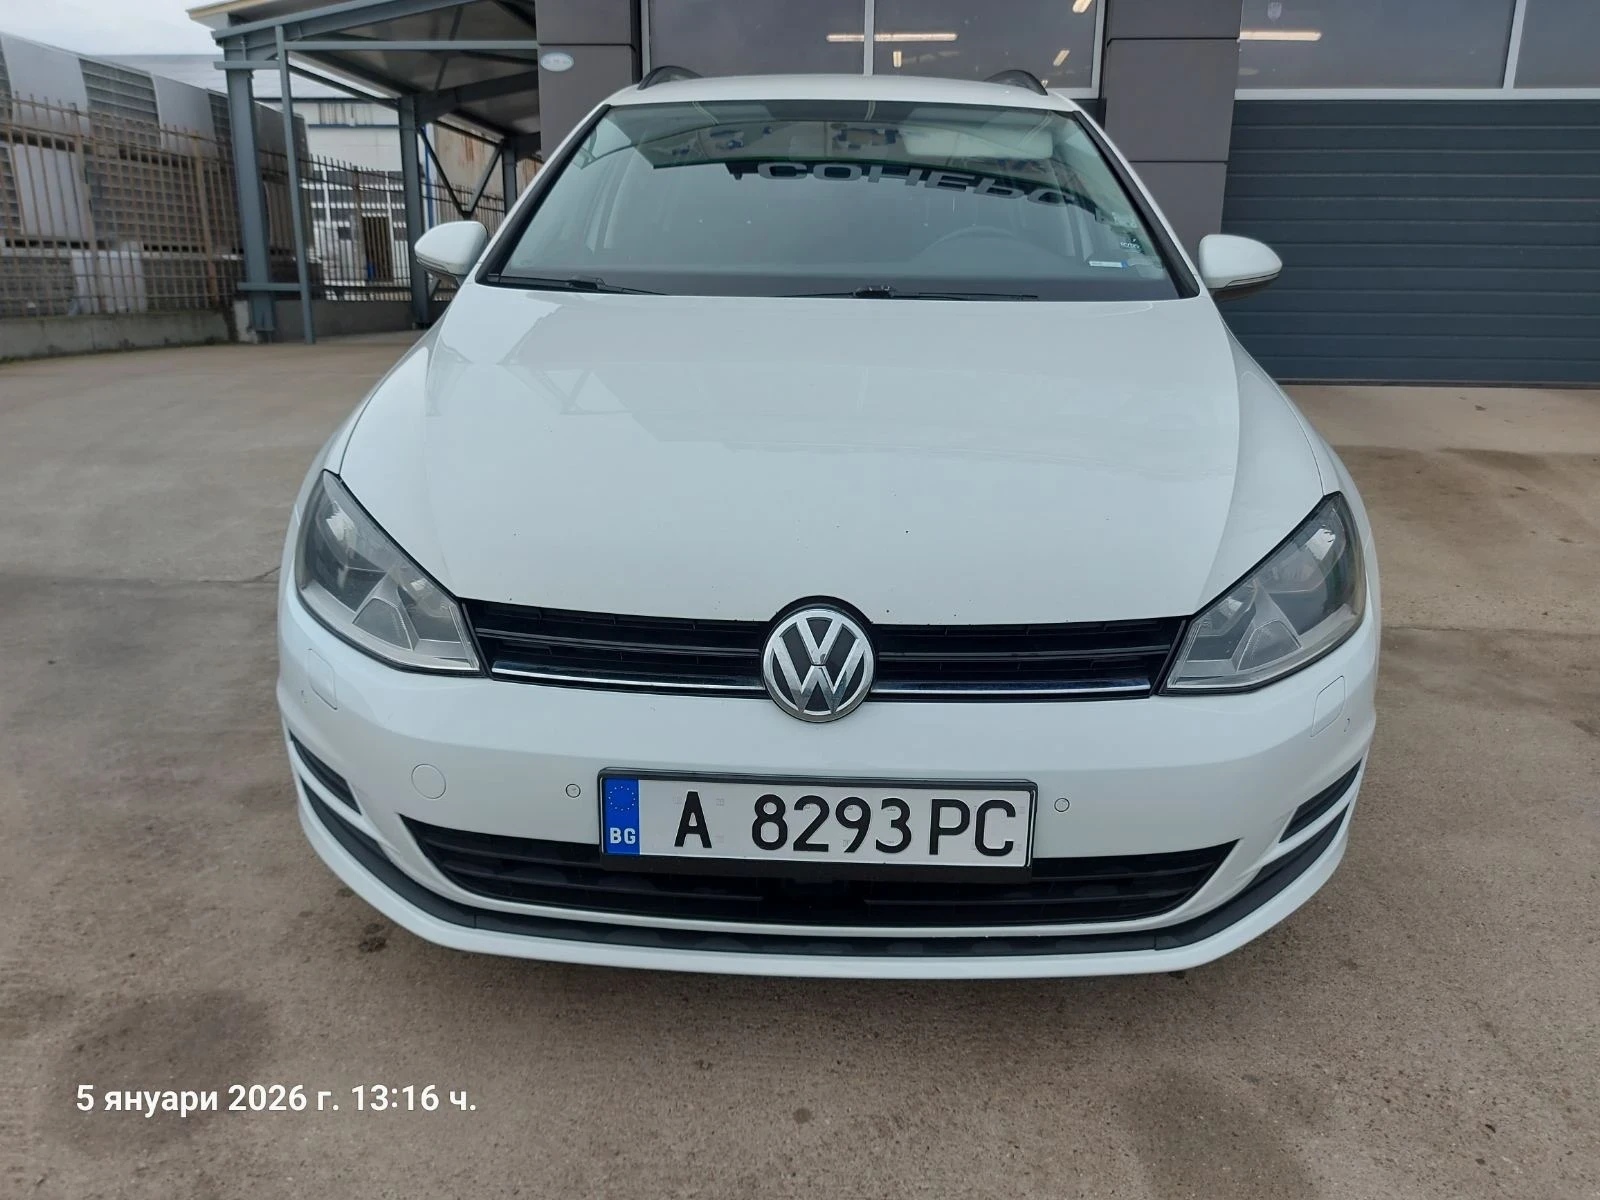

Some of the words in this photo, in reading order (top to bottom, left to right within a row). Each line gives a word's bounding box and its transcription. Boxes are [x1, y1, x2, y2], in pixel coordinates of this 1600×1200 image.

[763, 608, 874, 722] VW
[609, 827, 636, 845] BG
[674, 791, 713, 849] A
[751, 793, 912, 854] 8293
[929, 798, 1017, 857] PC
